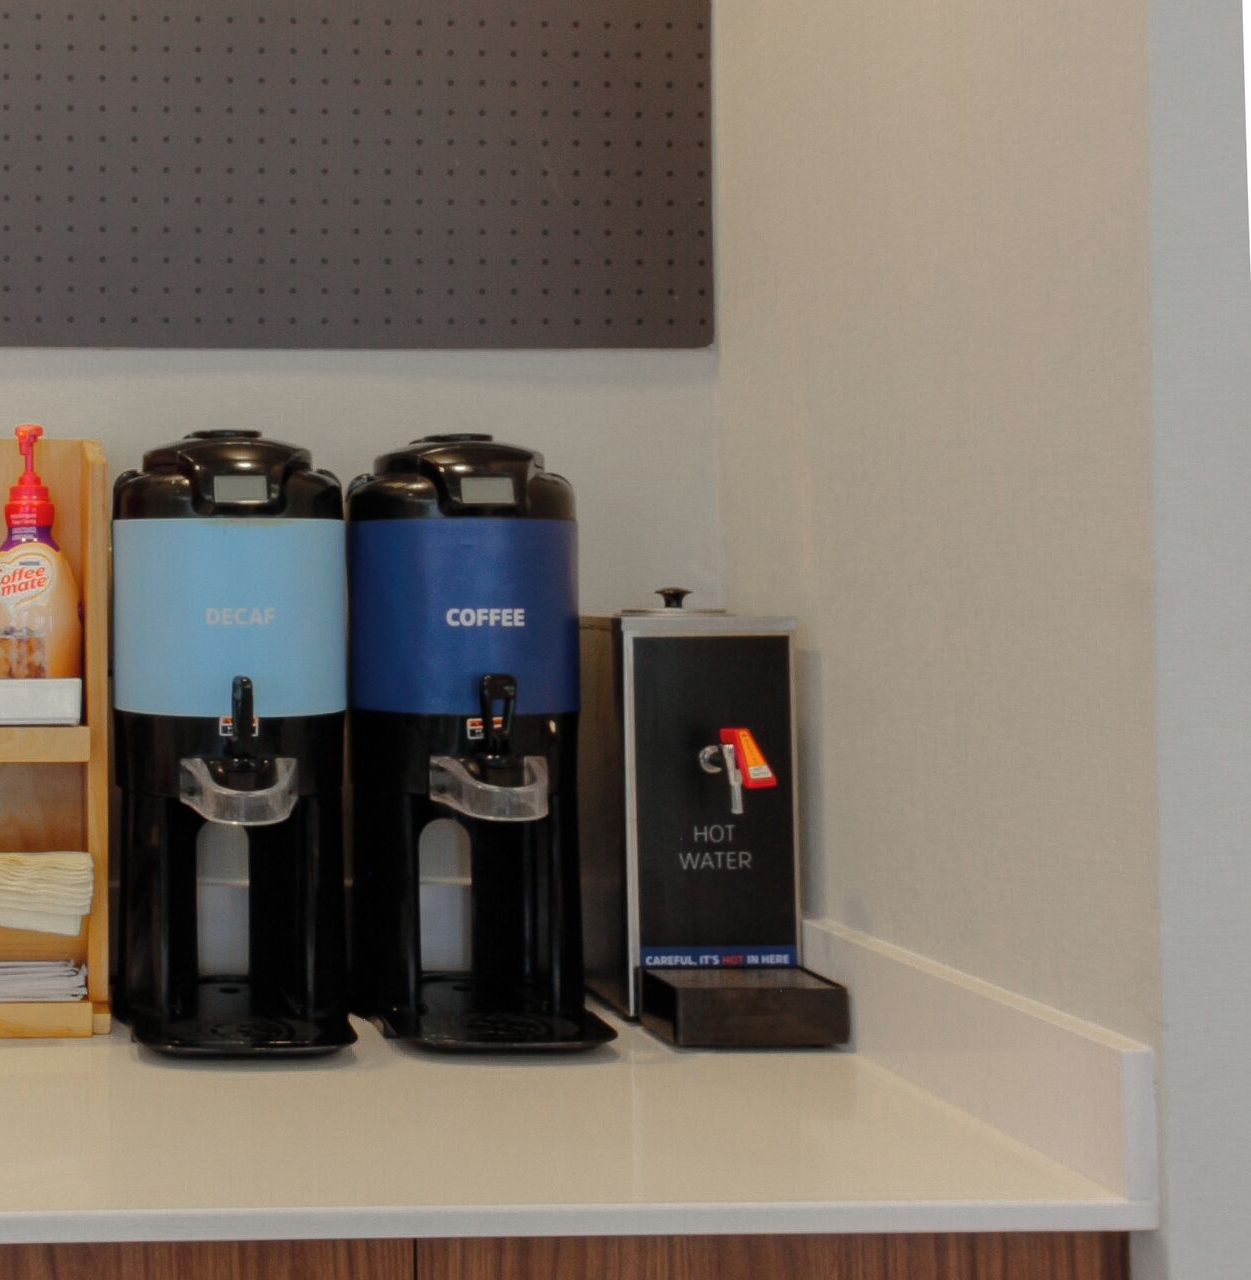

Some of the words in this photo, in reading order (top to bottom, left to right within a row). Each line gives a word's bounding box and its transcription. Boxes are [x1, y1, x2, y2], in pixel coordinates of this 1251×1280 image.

[1, 576, 47, 597] mate
[206, 608, 275, 625] DECAF
[446, 608, 525, 627] COFFEE
[693, 824, 736, 843] HOT
[679, 851, 752, 870] WATER
[746, 954, 759, 965] IN
[761, 954, 789, 965] HERE
